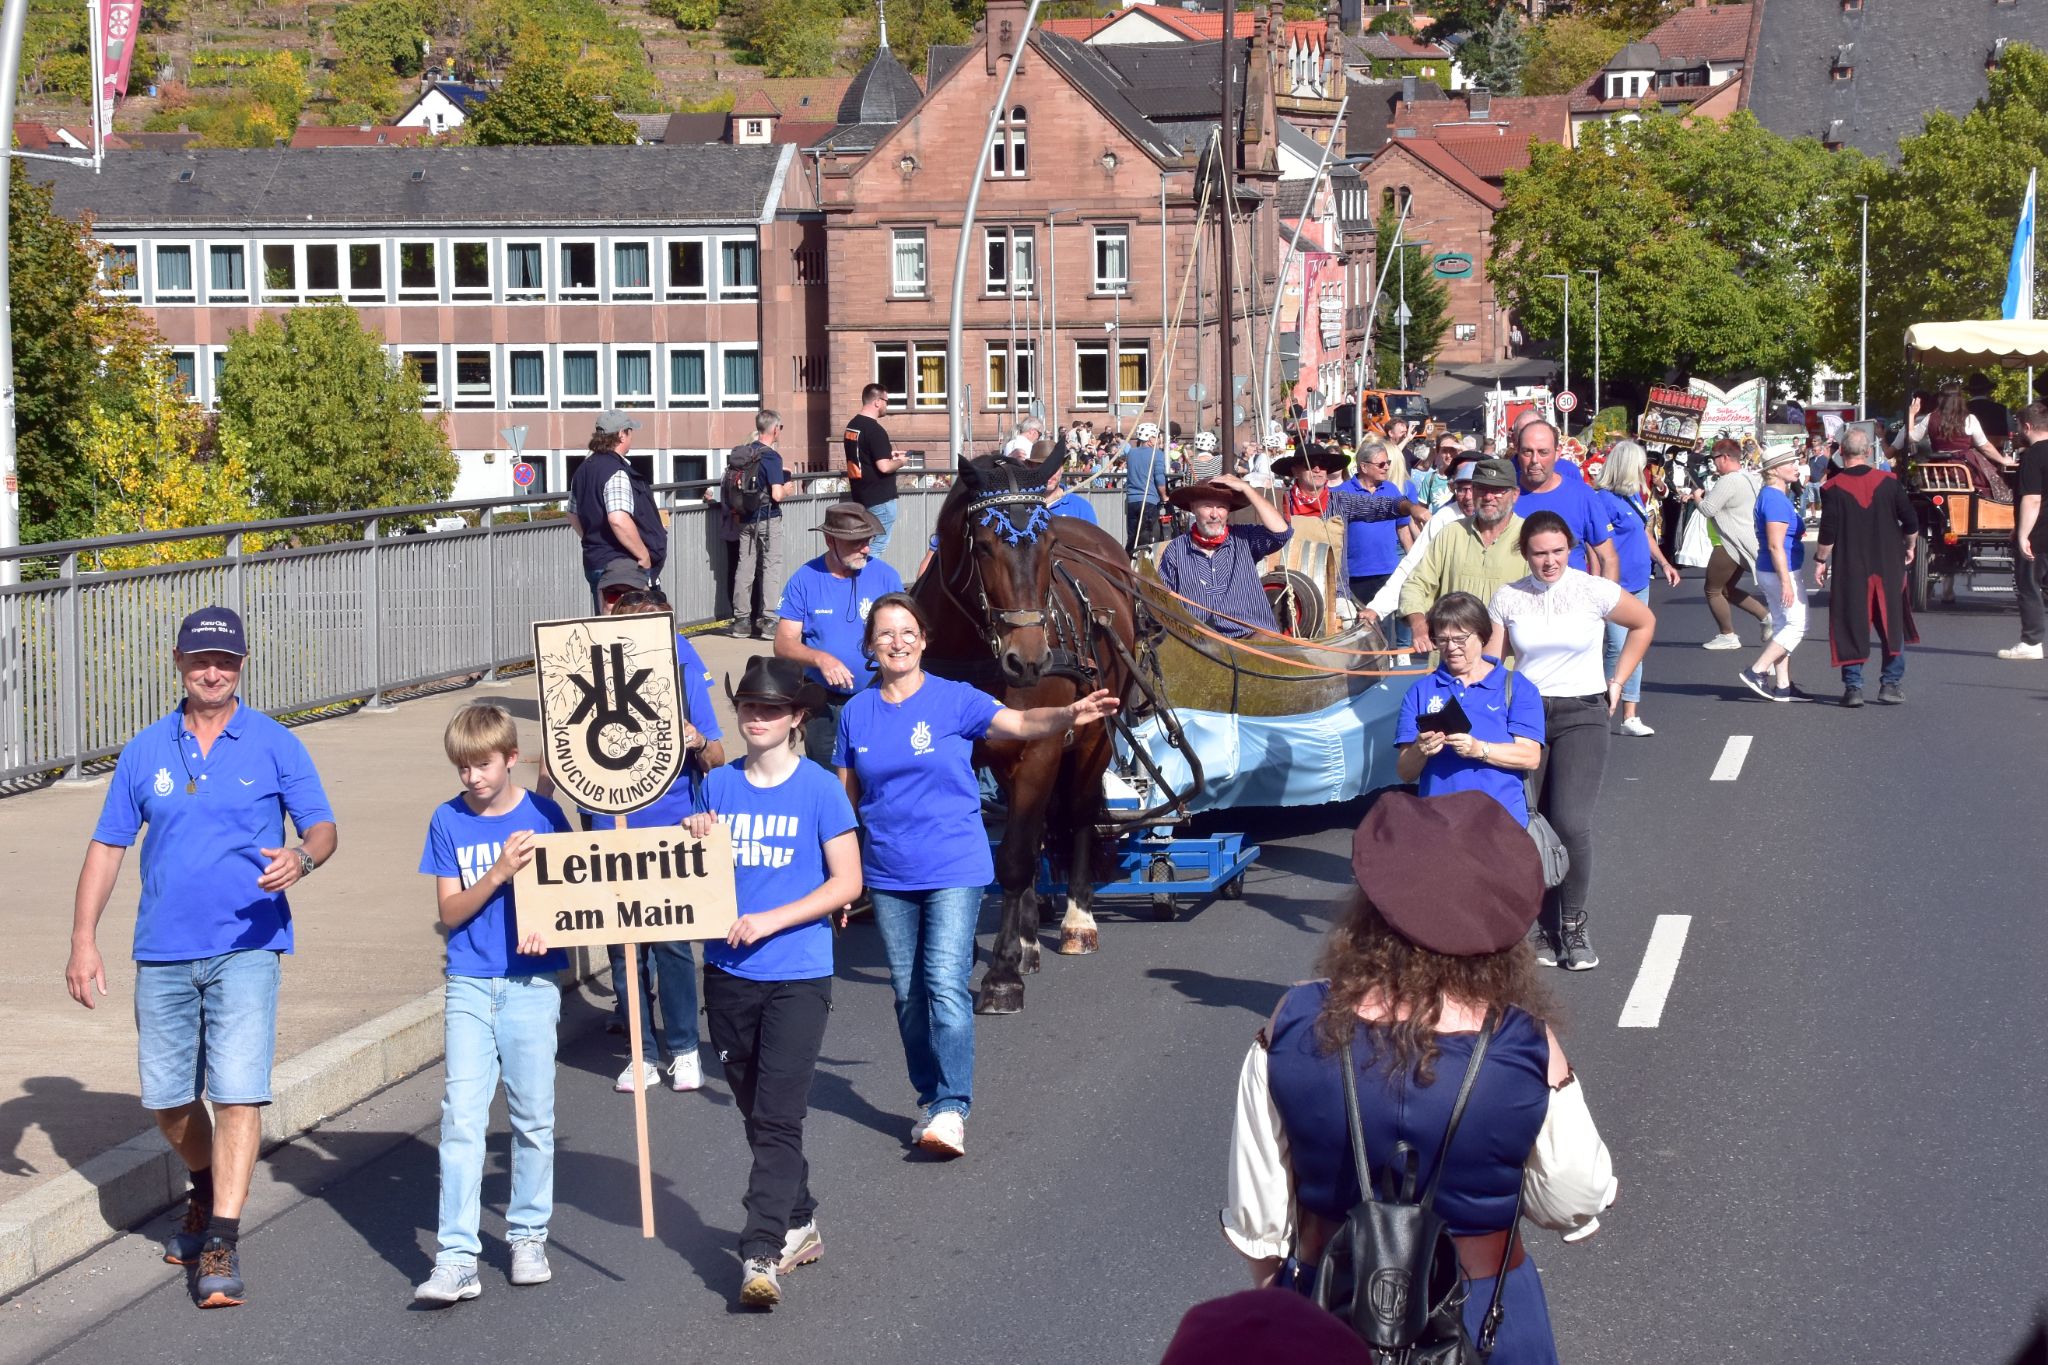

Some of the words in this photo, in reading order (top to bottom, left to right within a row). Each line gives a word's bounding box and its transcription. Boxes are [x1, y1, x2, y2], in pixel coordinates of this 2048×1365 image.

[1561, 397, 1572, 407] 30
[554, 726, 605, 802] KANUCLUB
[608, 719, 673, 805] KLINGENBERG
[535, 840, 709, 886] Leinritt
[555, 909, 604, 931] am
[616, 898, 695, 929] Main
